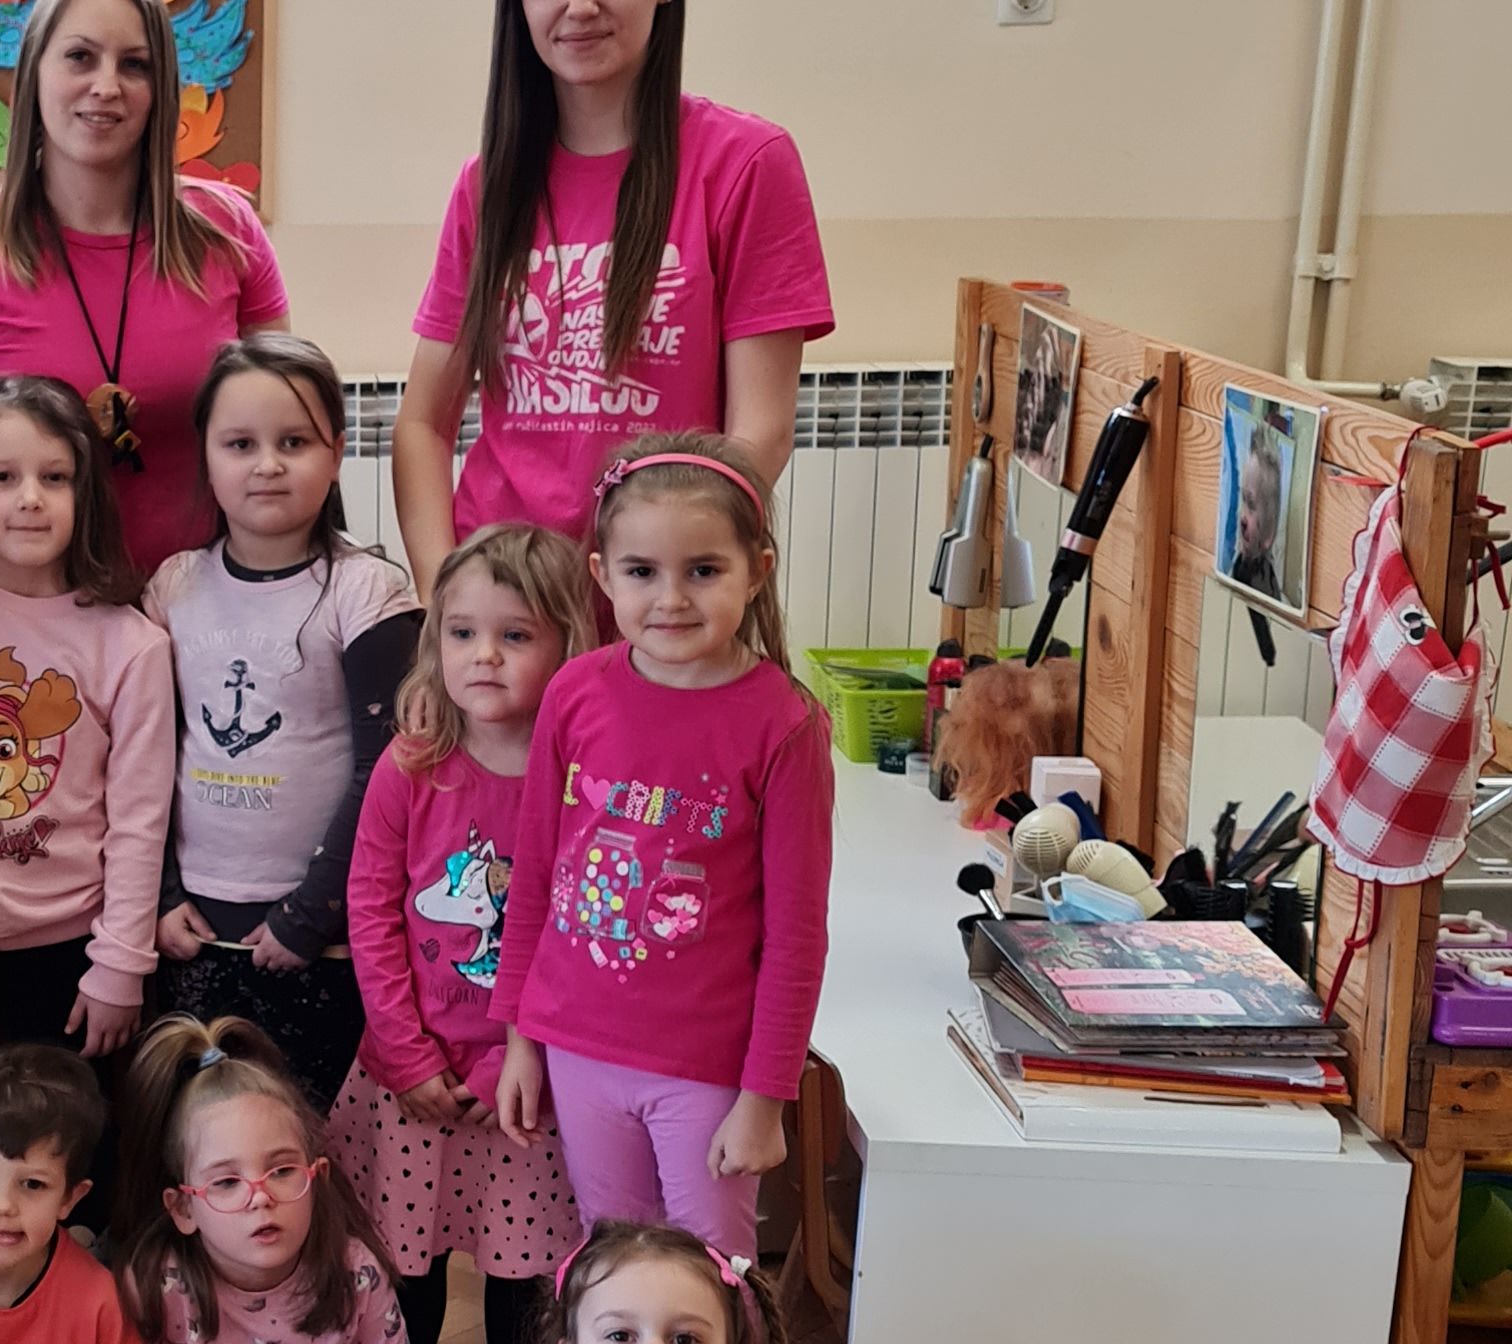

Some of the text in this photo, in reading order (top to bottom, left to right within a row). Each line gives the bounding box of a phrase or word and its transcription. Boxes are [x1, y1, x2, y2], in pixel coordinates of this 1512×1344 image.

[557, 326, 685, 355] PREAJE
[196, 780, 273, 810] OCEAN
[605, 779, 729, 839] CRAFTS
